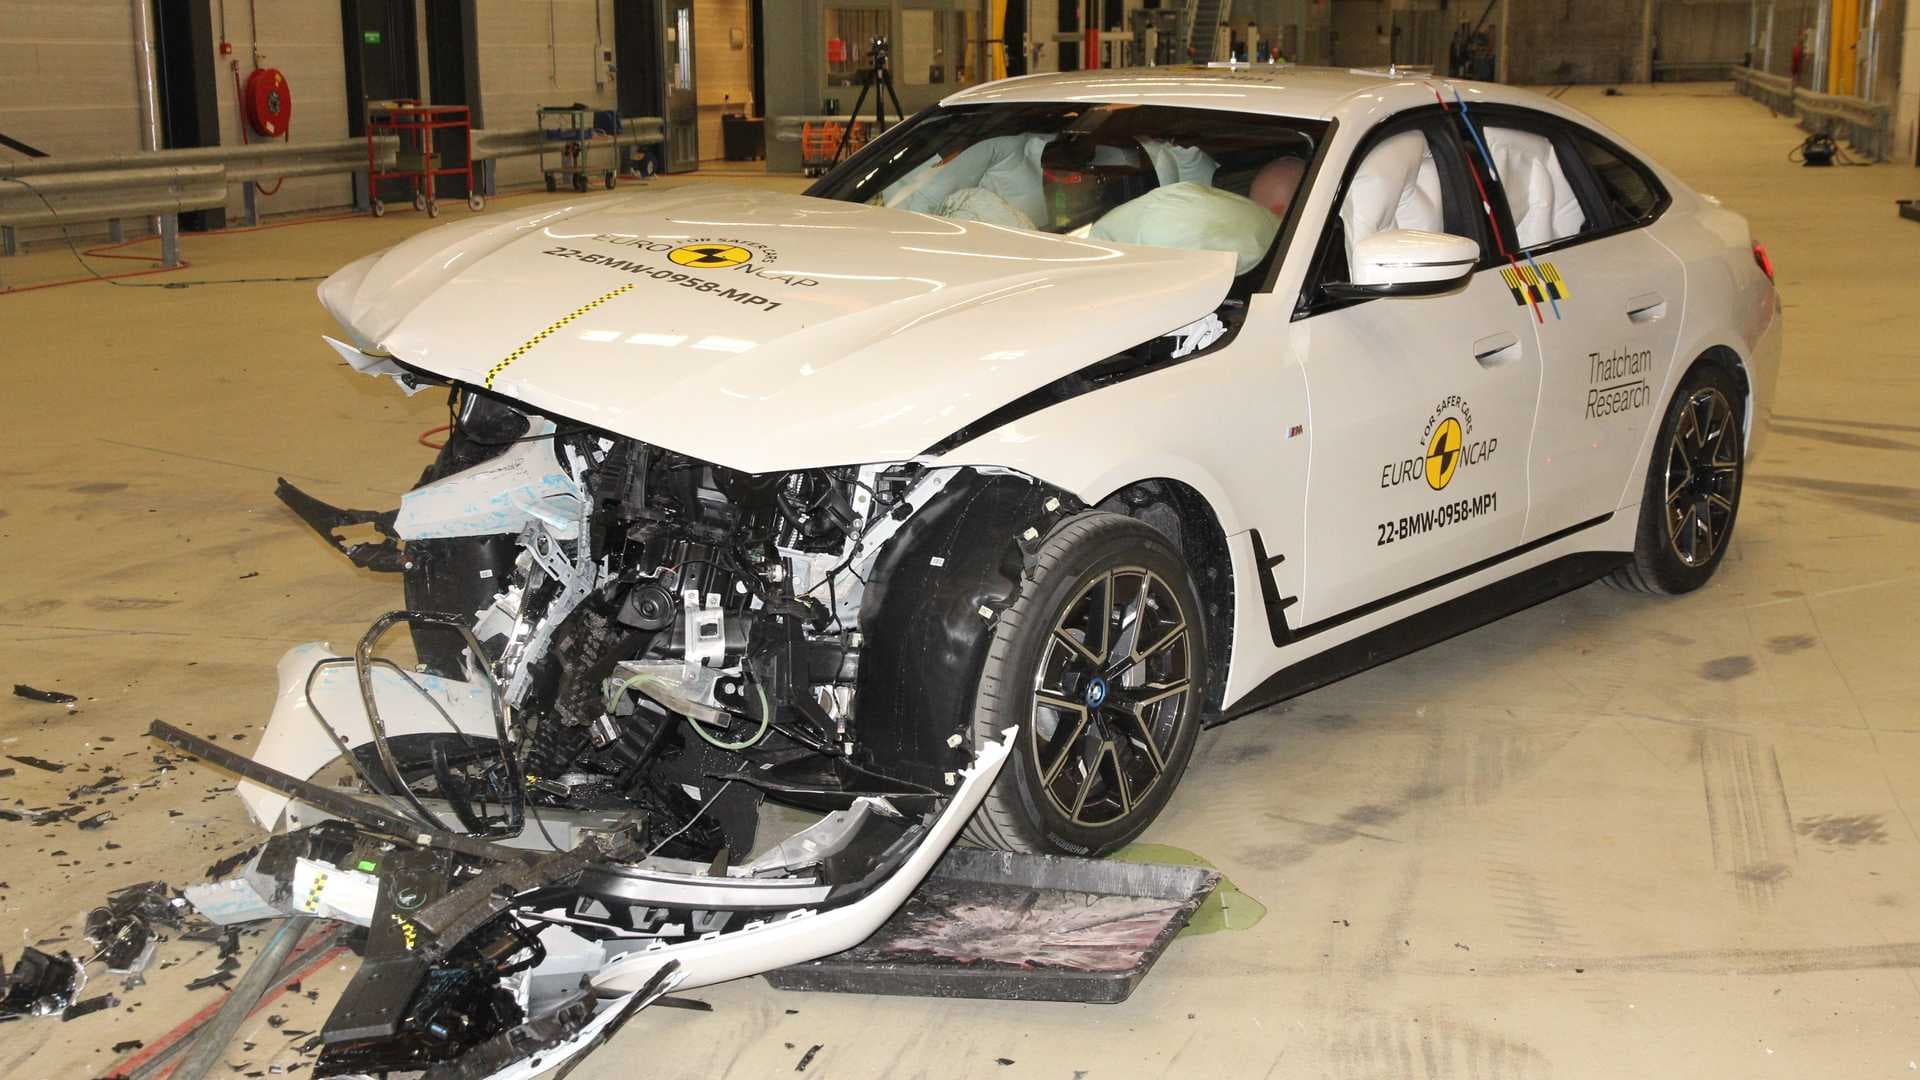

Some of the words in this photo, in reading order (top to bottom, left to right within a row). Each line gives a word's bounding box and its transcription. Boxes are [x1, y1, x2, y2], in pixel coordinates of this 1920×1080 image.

[543, 247, 782, 312] 22-BMW-0958-MP1
[592, 234, 673, 252] EURO
[733, 263, 819, 287] NCAP
[1588, 344, 1652, 384] Thatcham
[1420, 415, 1436, 446] FOR
[1436, 395, 1461, 416] SAFER
[1461, 402, 1472, 435] CARS
[1585, 377, 1650, 419] Research
[1381, 456, 1424, 488] EURO
[1460, 438, 1498, 468] NCAP
[1377, 491, 1497, 547] 22-BMW-0958-MP1
